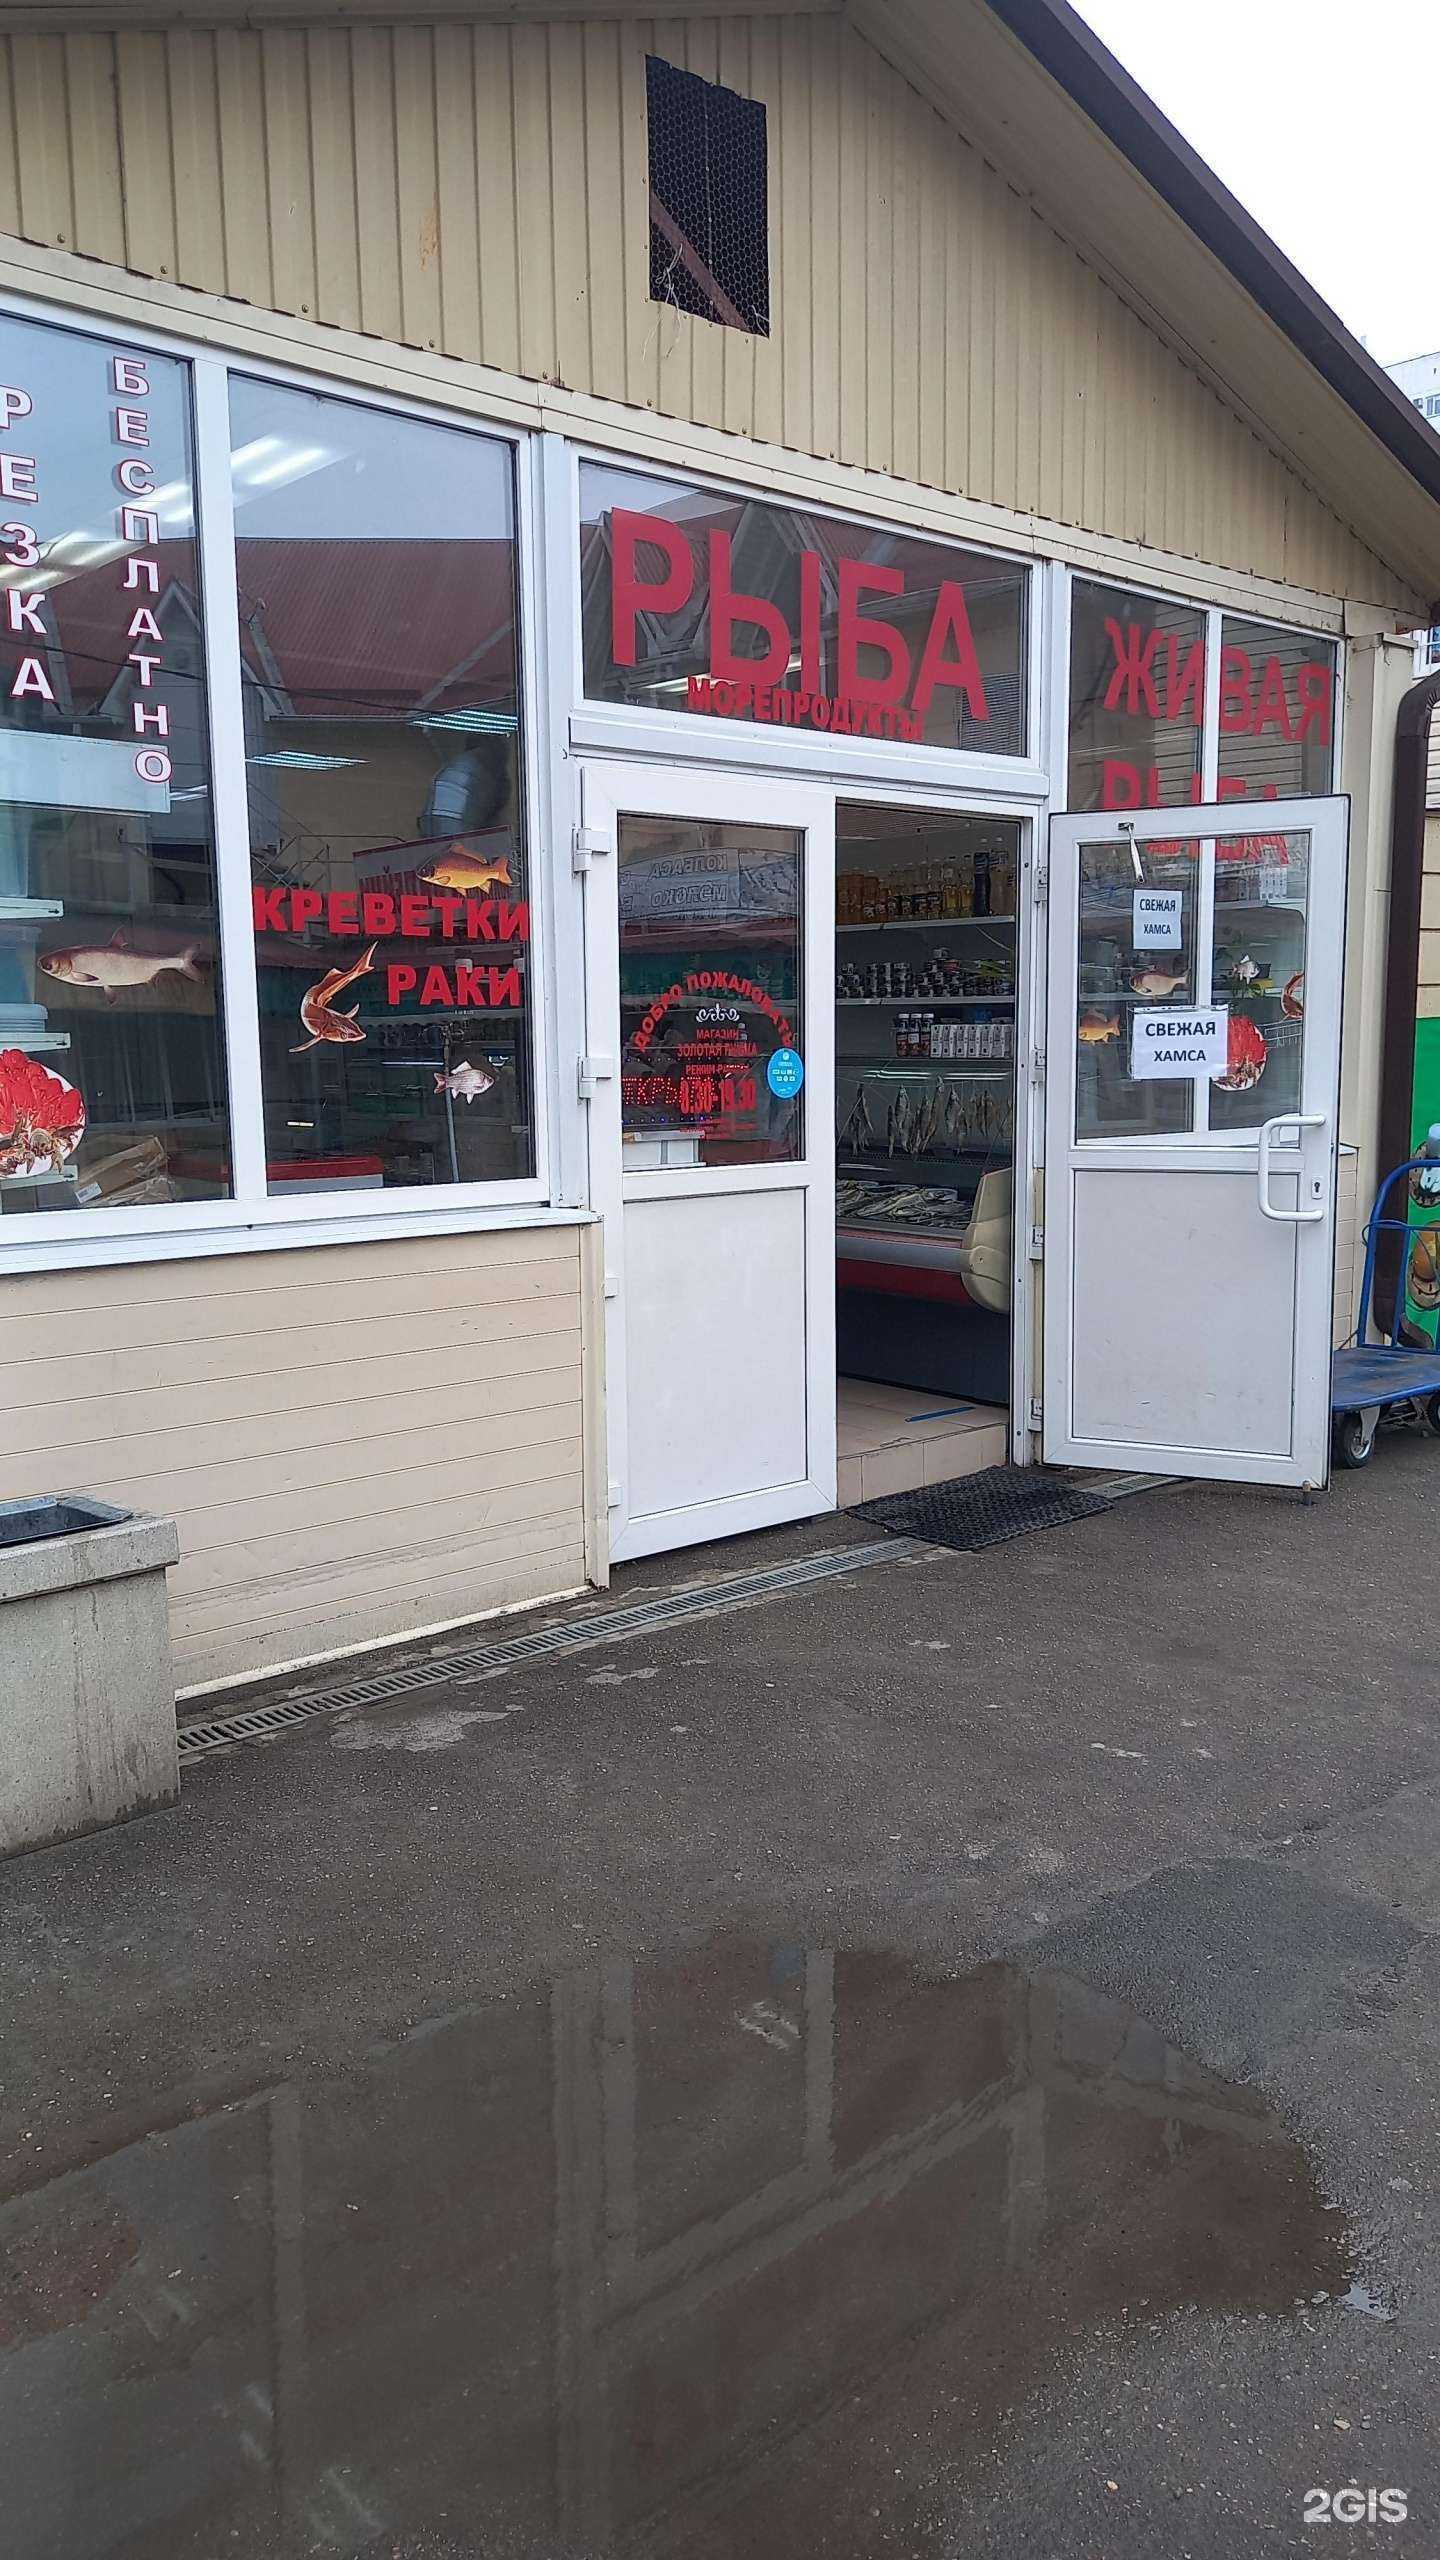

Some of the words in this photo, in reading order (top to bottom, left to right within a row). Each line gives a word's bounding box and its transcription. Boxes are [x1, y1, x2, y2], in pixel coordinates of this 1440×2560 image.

[0, 384, 54, 702] РЕЗКА
[112, 355, 173, 784] БЕСПЛАТНО
[610, 506, 990, 722] РЫБА
[1103, 616, 1330, 747] ЖИВАЯ
[687, 675, 924, 742] МОРЕПРОДУКТЫ
[253, 886, 530, 942] КРЕВЕТКИ
[1139, 898, 1176, 912] СВЕЖАЯ
[1143, 923, 1172, 935] ХАМСА
[388, 963, 520, 1007] РАКИ
[634, 984, 682, 1052] ДОБРО
[696, 1029, 739, 1040] МАГАЗИН
[1145, 1021, 1216, 1037] СВЕЖАЯ
[677, 1042, 722, 1057] ЗОЛОТАЯ
[1153, 1050, 1207, 1062] ХАМСА
